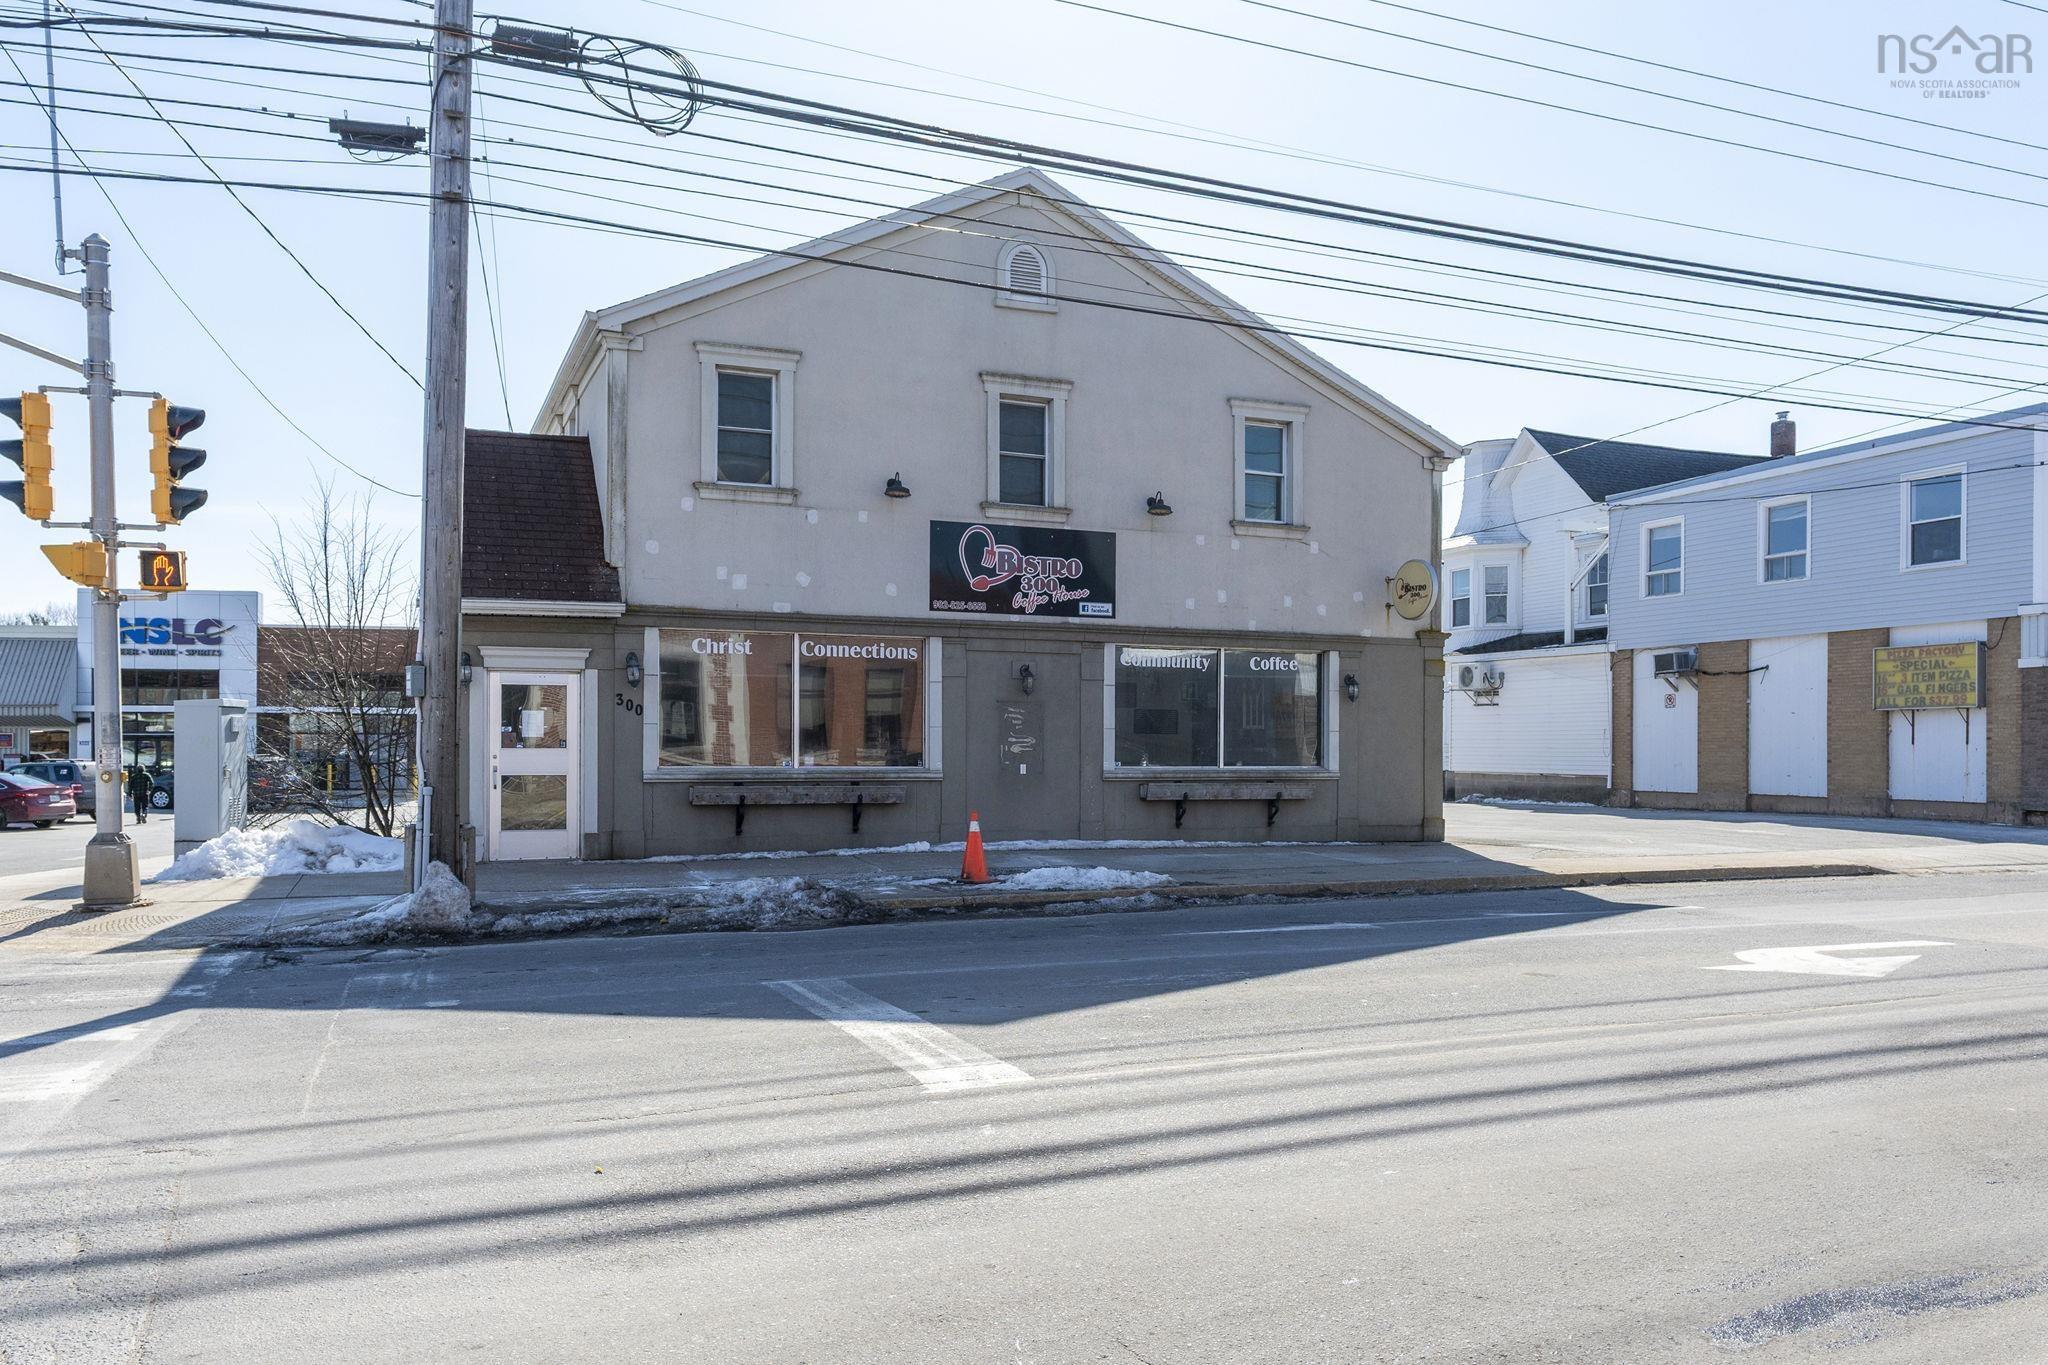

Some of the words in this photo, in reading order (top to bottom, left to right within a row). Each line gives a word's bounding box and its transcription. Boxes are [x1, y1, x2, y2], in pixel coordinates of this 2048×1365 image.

[996, 550, 1083, 579] BISTRO
[1021, 575, 1059, 594] 300
[1012, 591, 1050, 614] Coffee
[1052, 585, 1090, 604] House
[120, 617, 223, 645] NSLC
[147, 648, 176, 656] WINE
[184, 648, 222, 657] SPIRITS
[691, 637, 752, 656] Christ
[800, 640, 918, 660] Connections
[1887, 649, 1915, 659] PIZZA
[1119, 651, 1211, 672] Community
[1249, 656, 1298, 671] Coffee
[1899, 659, 1947, 671] SPECIAL
[1911, 671, 1936, 683] ITEM
[1939, 670, 1971, 682] PIZZA
[615, 693, 643, 716] 300
[1879, 697, 1898, 707] ALL
[1904, 696, 1926, 707] FOR
